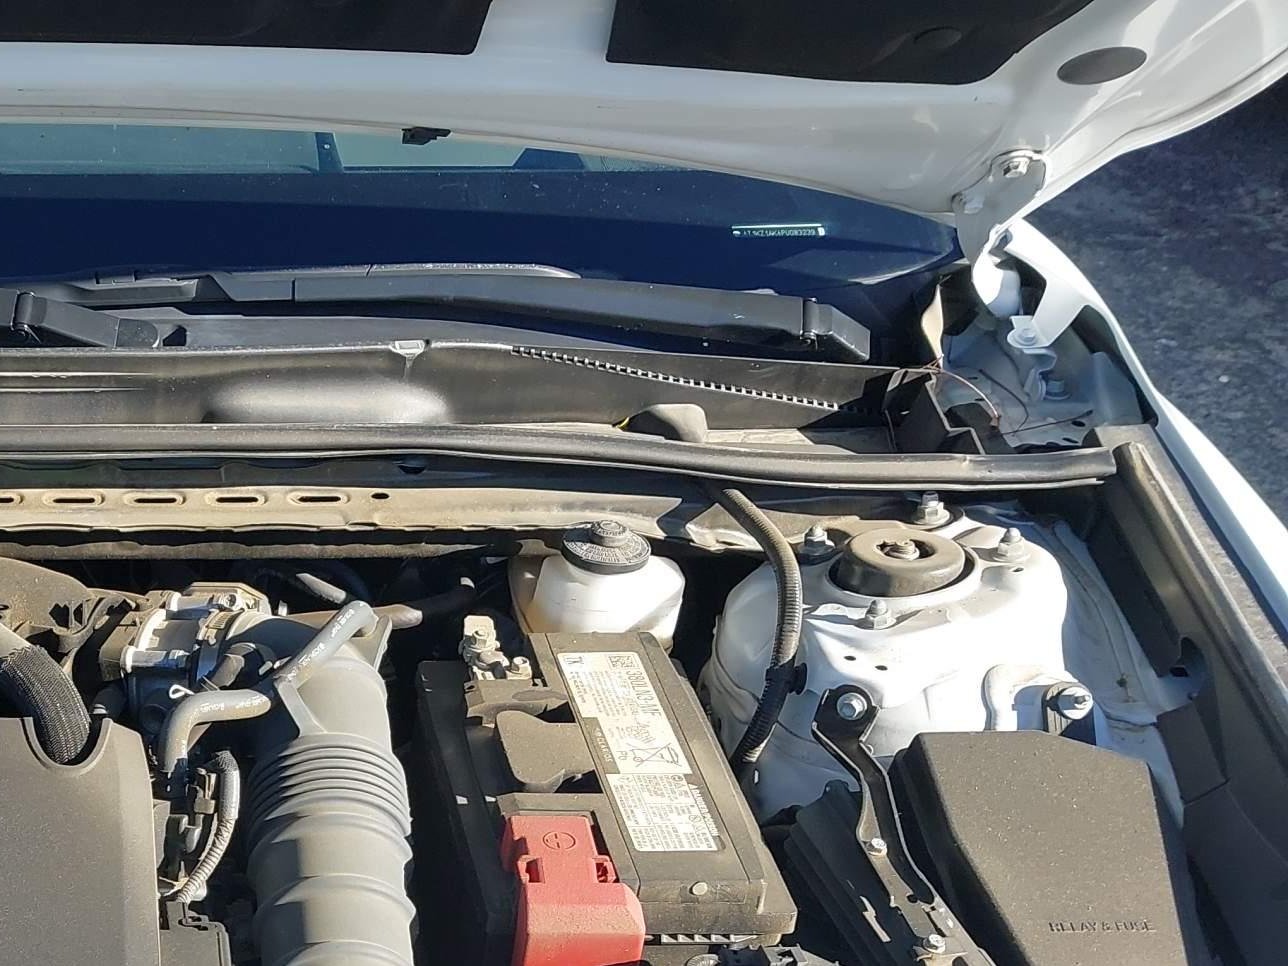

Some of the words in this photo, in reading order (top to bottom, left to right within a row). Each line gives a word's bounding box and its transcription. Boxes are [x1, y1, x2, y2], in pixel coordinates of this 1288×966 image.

[1048, 921, 1097, 933] RELAY
[1101, 921, 1113, 932] &
[1115, 920, 1157, 933] FUSE
